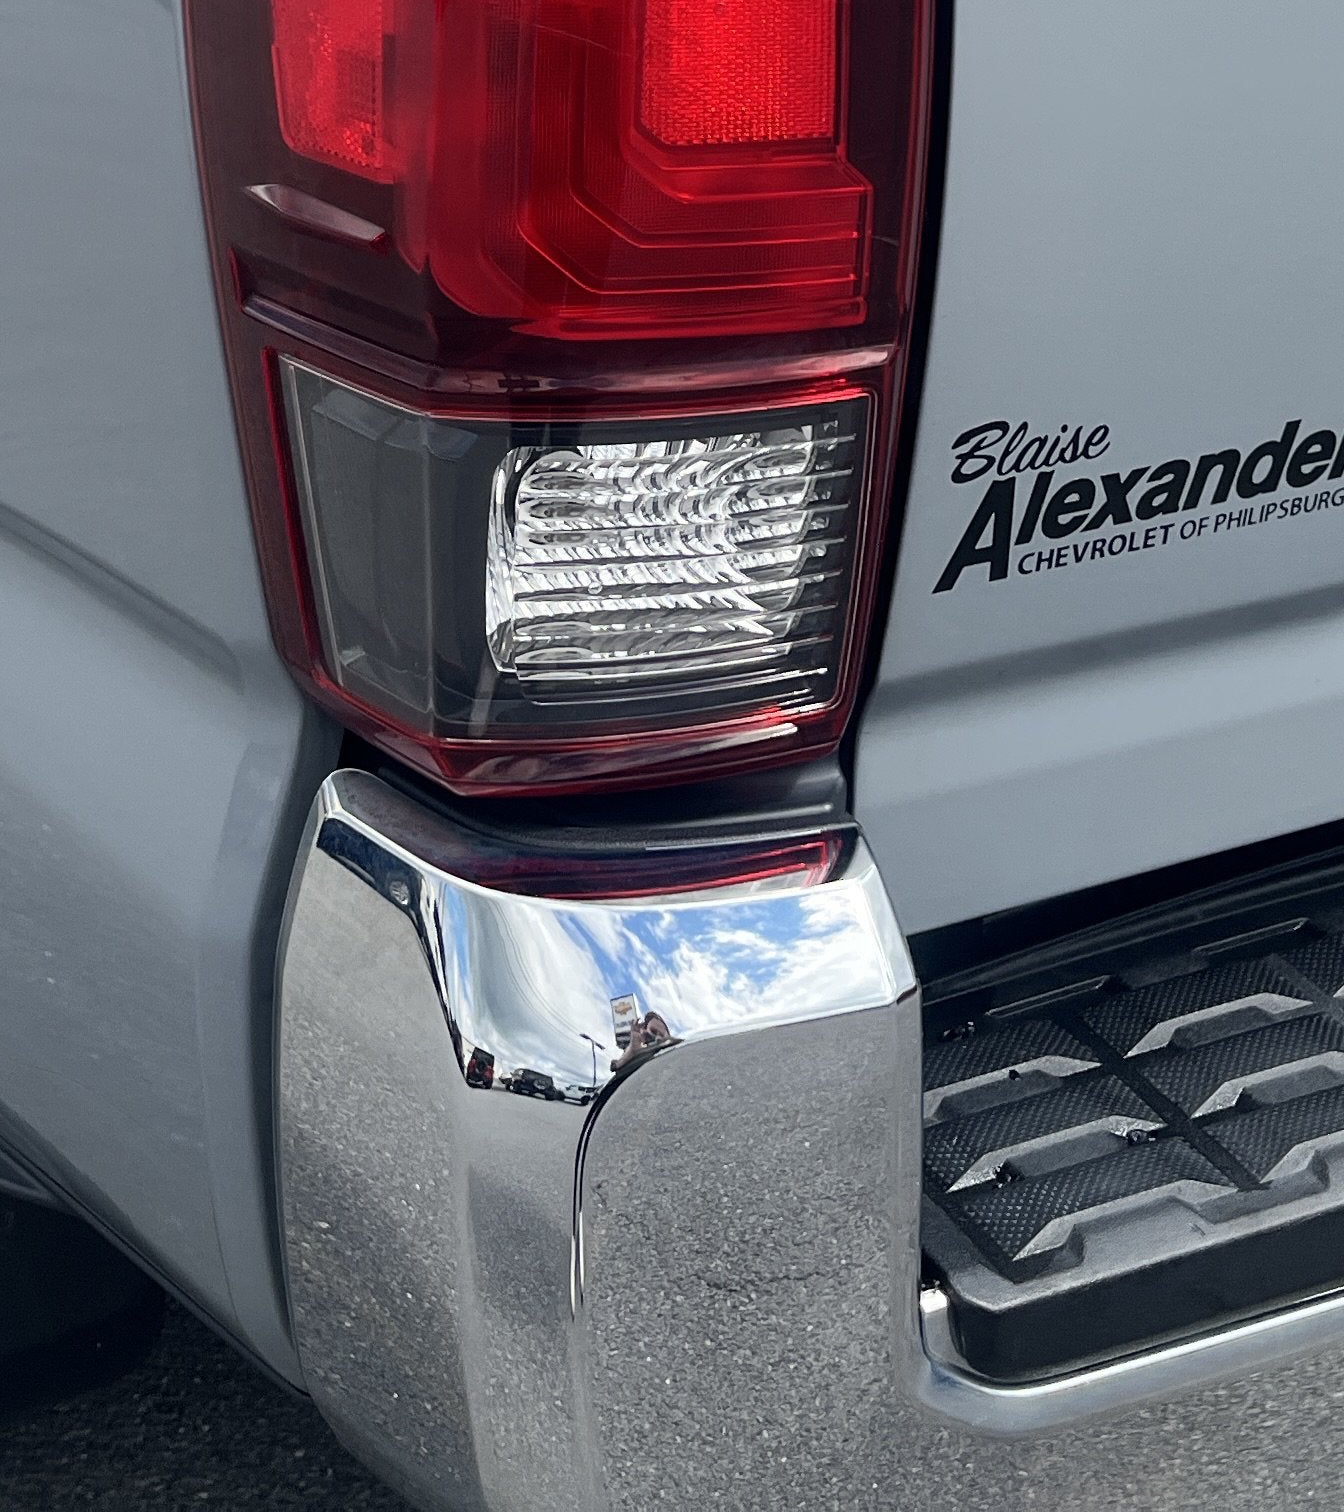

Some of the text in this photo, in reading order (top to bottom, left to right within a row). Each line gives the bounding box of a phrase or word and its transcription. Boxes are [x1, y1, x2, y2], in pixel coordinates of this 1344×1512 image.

[951, 420, 1111, 485] Blaise
[1017, 523, 1176, 576] CHEVROLET
[1179, 517, 1211, 541] OF
